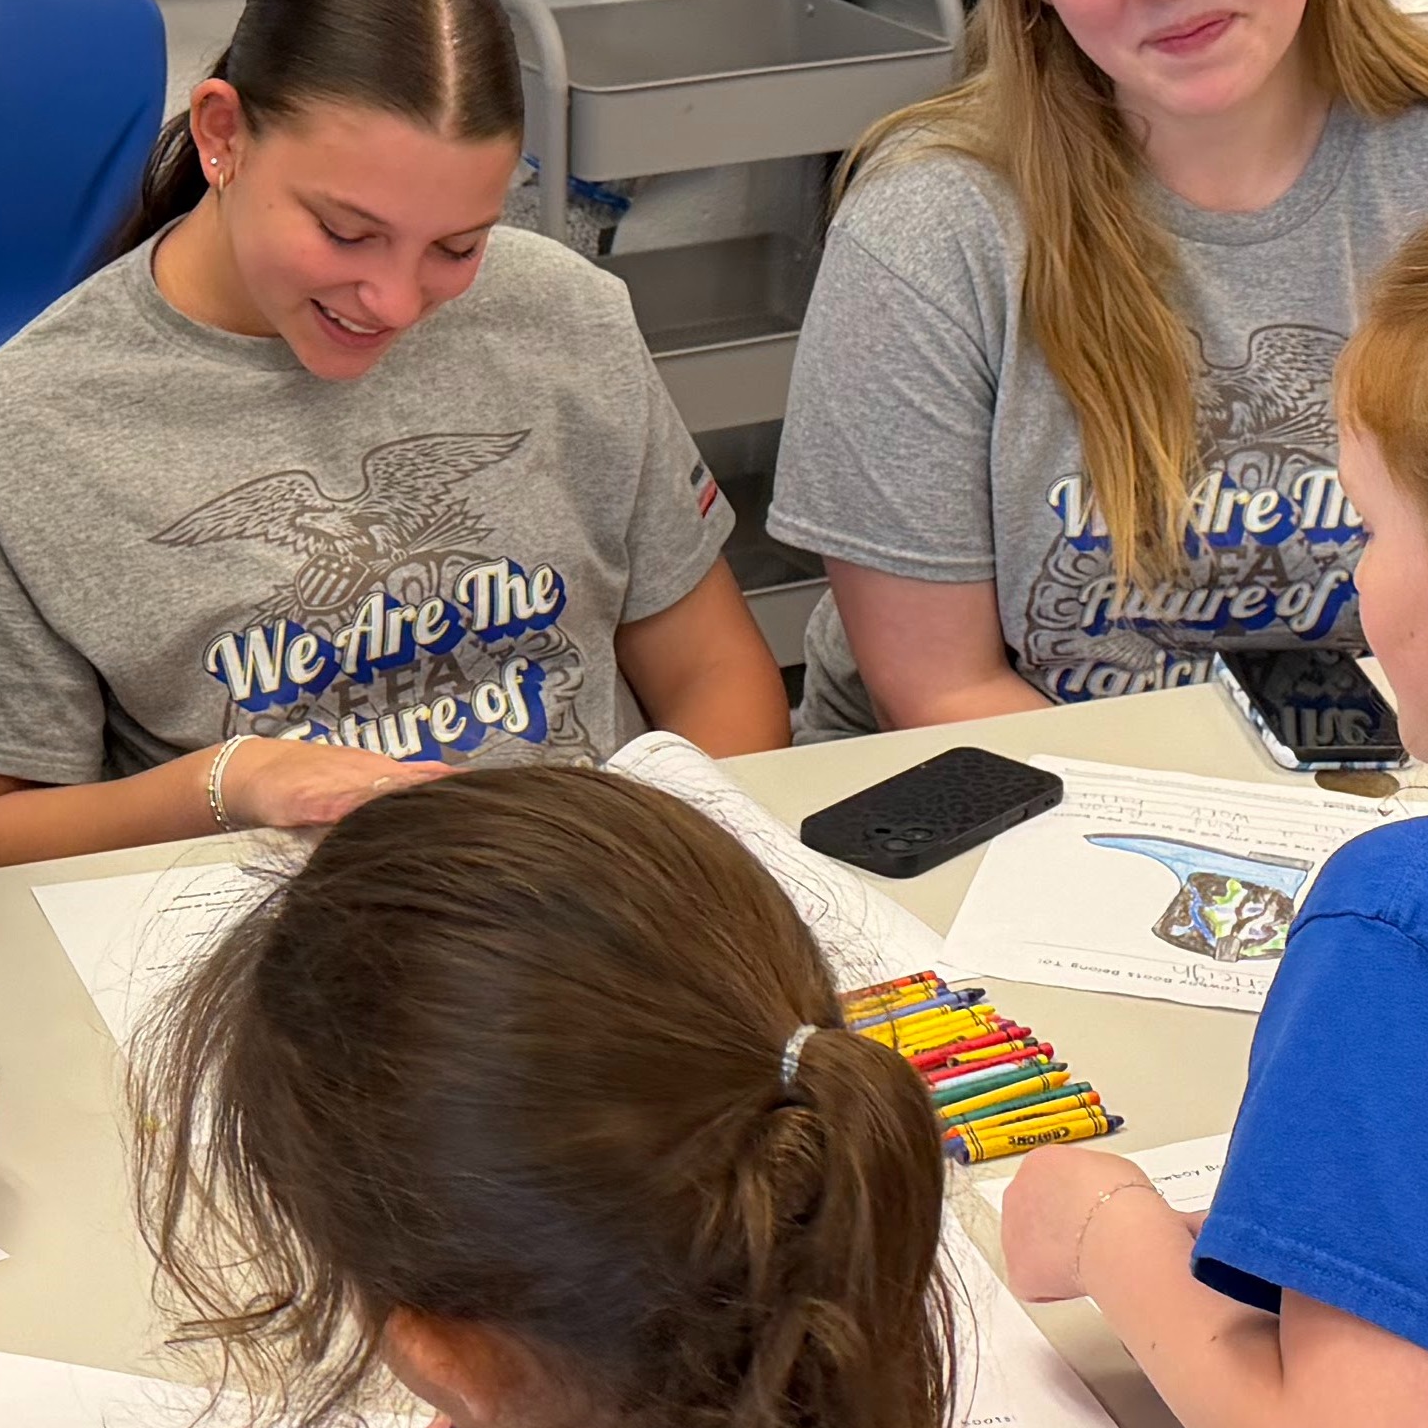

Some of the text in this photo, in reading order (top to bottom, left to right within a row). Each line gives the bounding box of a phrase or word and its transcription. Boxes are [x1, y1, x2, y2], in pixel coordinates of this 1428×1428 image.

[1188, 470, 1280, 534] Are
[205, 556, 563, 706] We Are The
[1276, 570, 1350, 634] of
[470, 656, 531, 736] of
